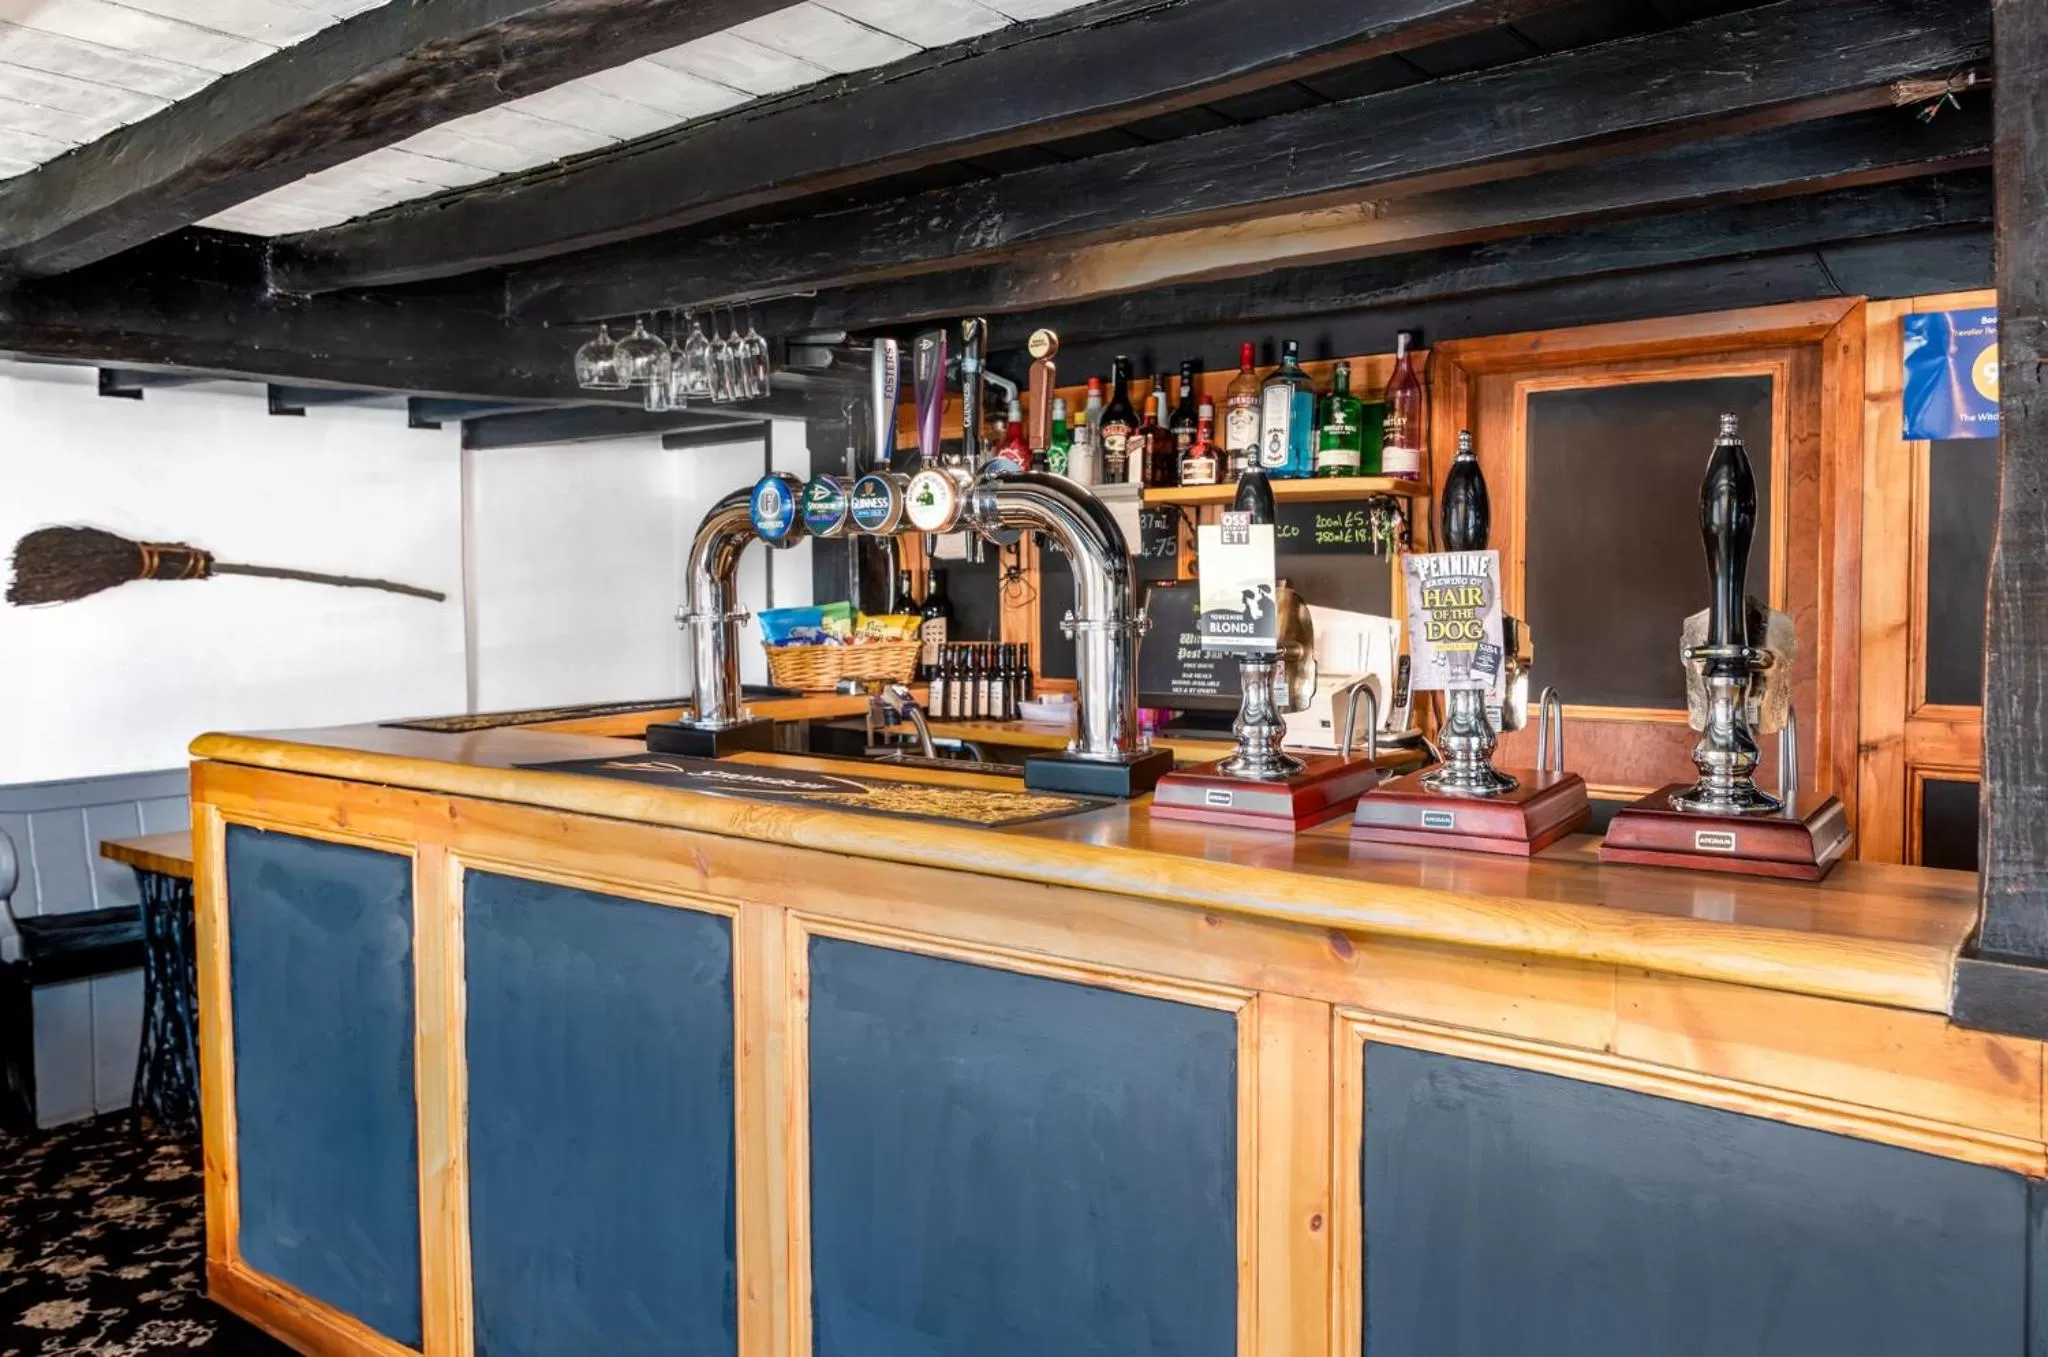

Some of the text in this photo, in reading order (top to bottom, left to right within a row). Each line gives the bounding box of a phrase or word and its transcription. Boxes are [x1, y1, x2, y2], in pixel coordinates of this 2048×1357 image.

[1959, 412, 1976, 422] The
[1414, 555, 1491, 580] PENNINE
[1423, 587, 1485, 609] HAIR
[1433, 607, 1475, 620] OF THE
[1209, 621, 1255, 634] BLONDE
[1425, 620, 1485, 641] DOG
